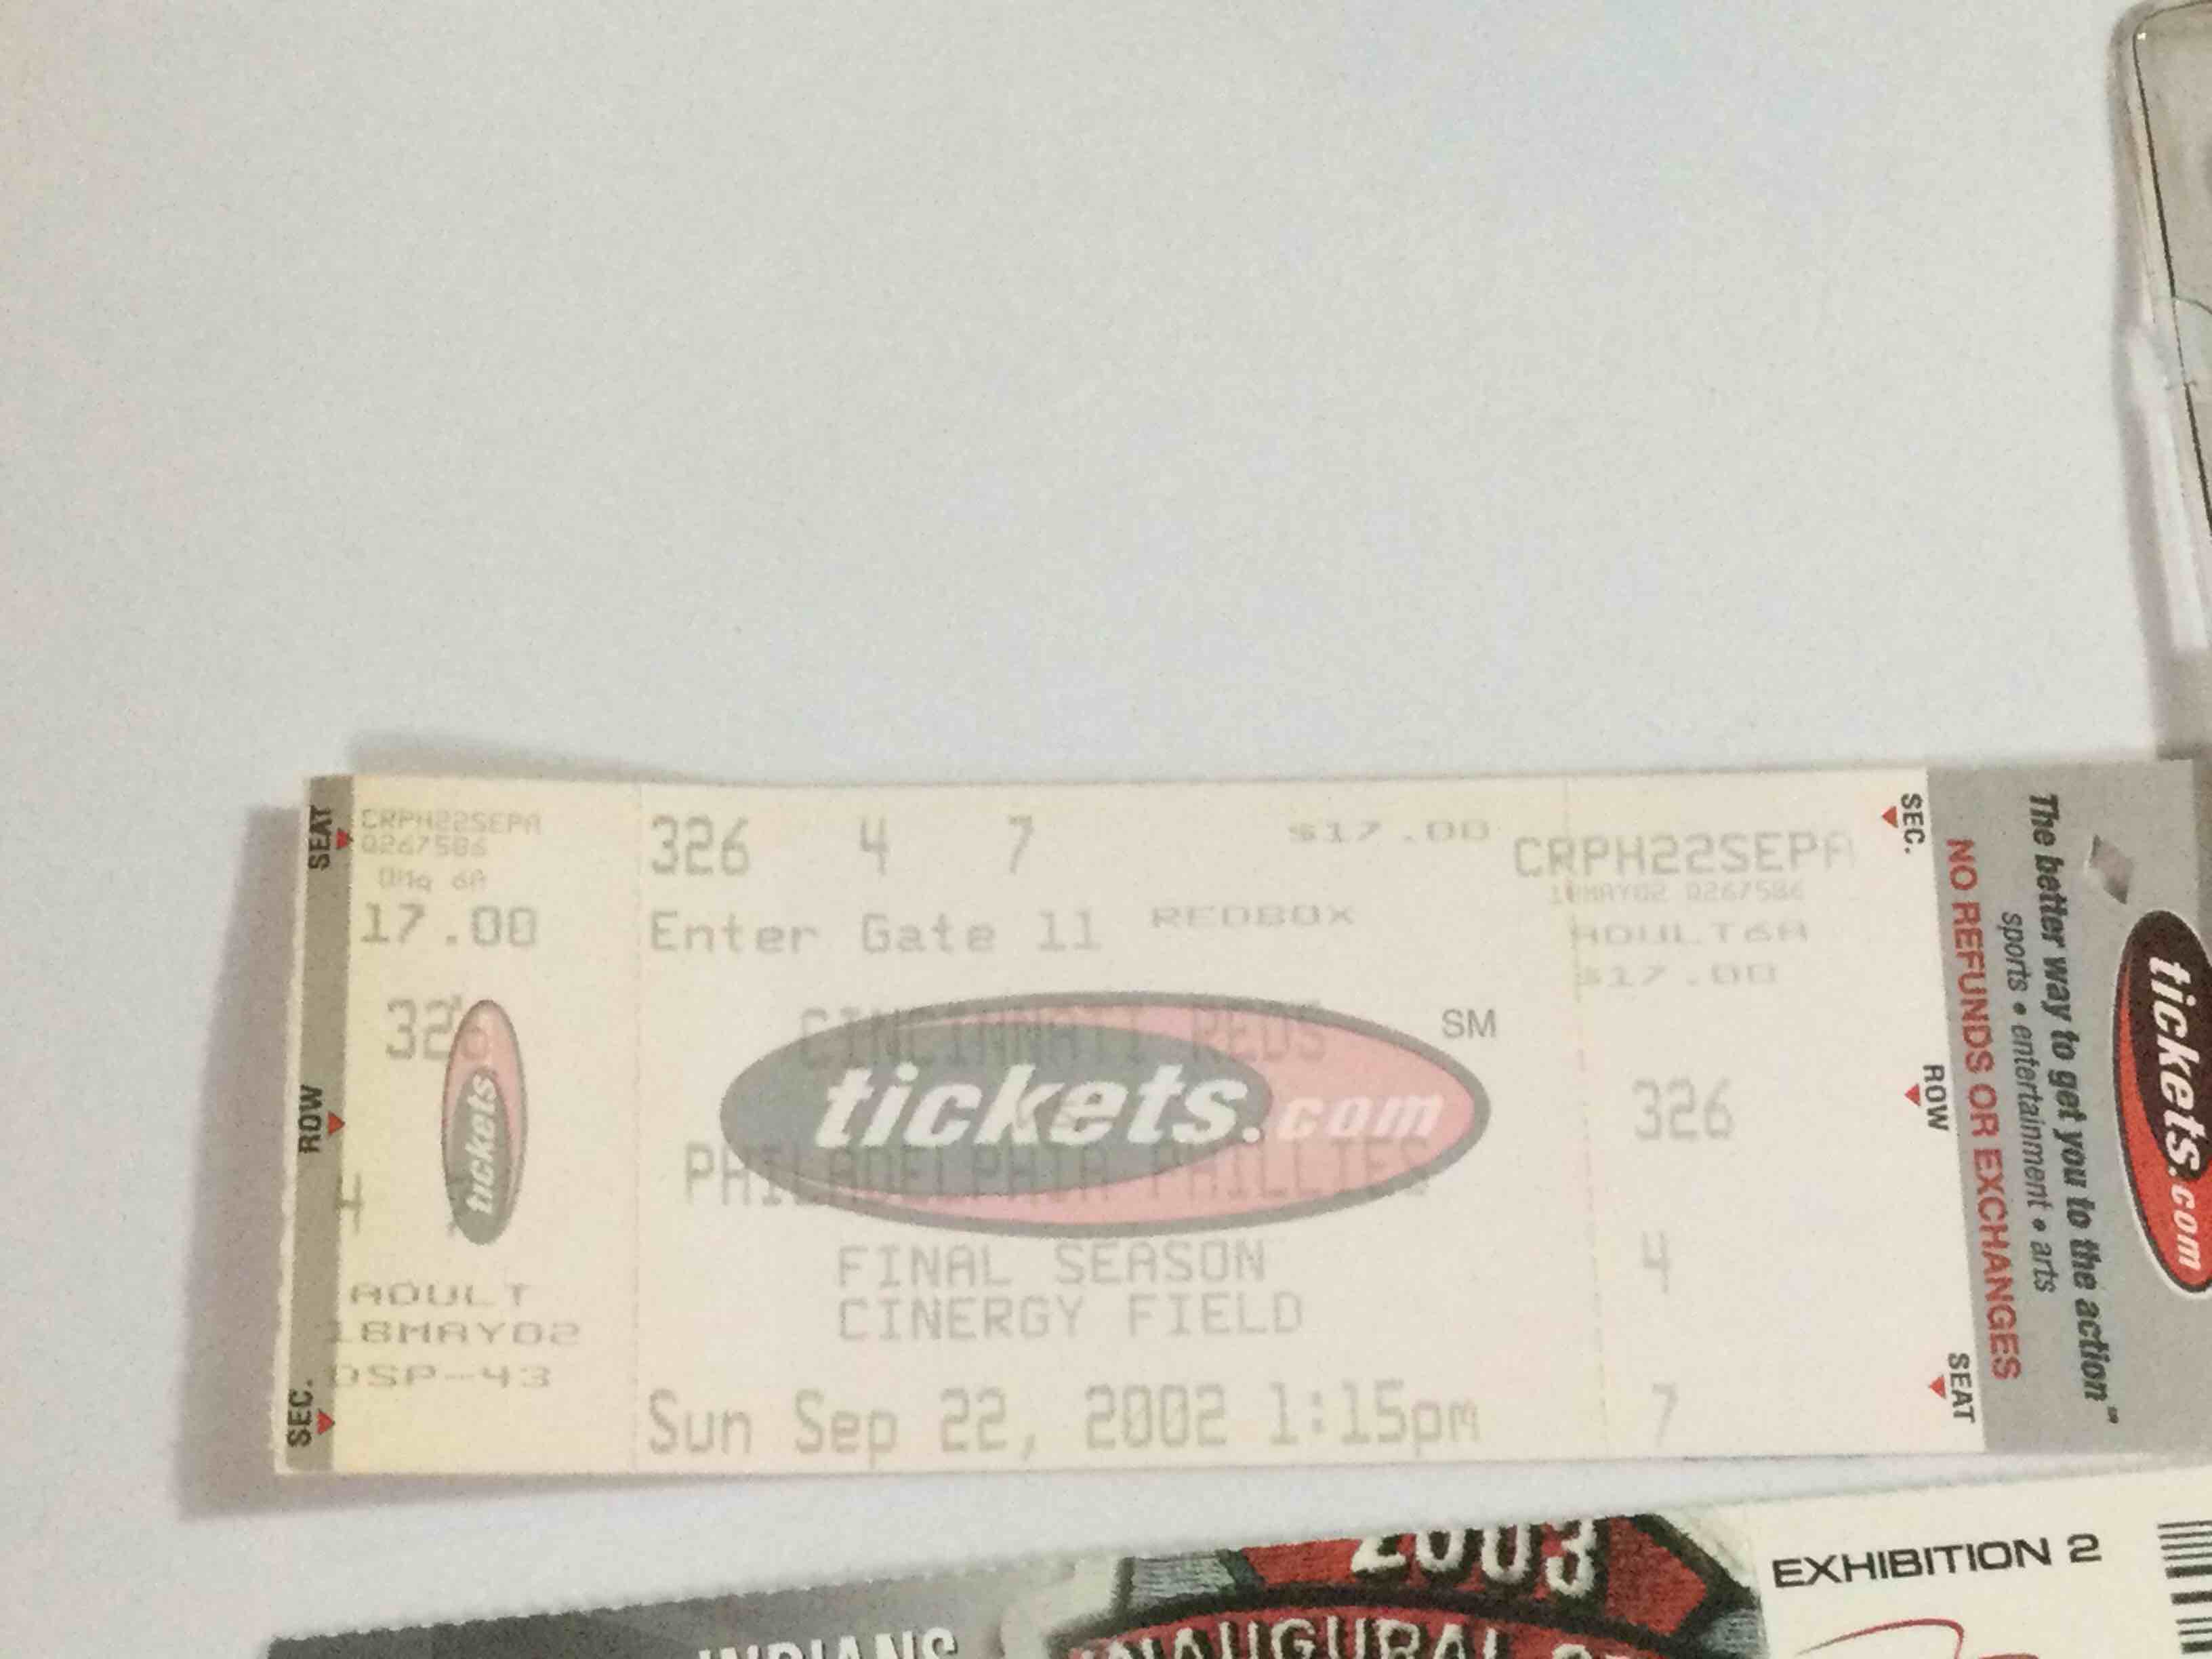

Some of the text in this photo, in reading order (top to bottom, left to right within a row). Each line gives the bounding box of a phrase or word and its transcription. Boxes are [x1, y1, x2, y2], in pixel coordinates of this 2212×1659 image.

[308, 805, 331, 871] SEAT
[651, 813, 1491, 878] 326 4 7 $17.00
[1513, 830, 1856, 878] CRPH22SEPA
[1900, 792, 1926, 855] SEC.
[360, 902, 537, 947] 17.00
[650, 904, 1357, 955] Enter Gate 11 REDBOX
[1441, 1008, 1497, 1040] SM
[298, 1084, 323, 1153] ROW
[1633, 1078, 1734, 1143] 326
[1922, 1063, 1950, 1132] ROW
[1946, 838, 2023, 1381] NO REFUNDS OR EXCHANGES
[1996, 910, 2060, 1294] sports entertainment arts
[2029, 794, 2112, 1404] The better way to get you to the action
[2148, 956, 2208, 1271] tickets.com
[838, 1239, 1267, 1288] FINAL SEASON
[1641, 1229, 1671, 1294] 4
[839, 1290, 1303, 1342] CINERGY FIELD
[287, 1380, 314, 1448] SEC.
[1652, 1380, 1679, 1448] 7
[1947, 1352, 1976, 1423] SEAT
[648, 1378, 1482, 1469] Sun Sep 22, 2002 1:15pm
[1771, 1532, 2103, 1589] EXHIBITION 2
[698, 1626, 960, 1659] IANS
[1080, 1614, 1499, 1659] AUGURAL
